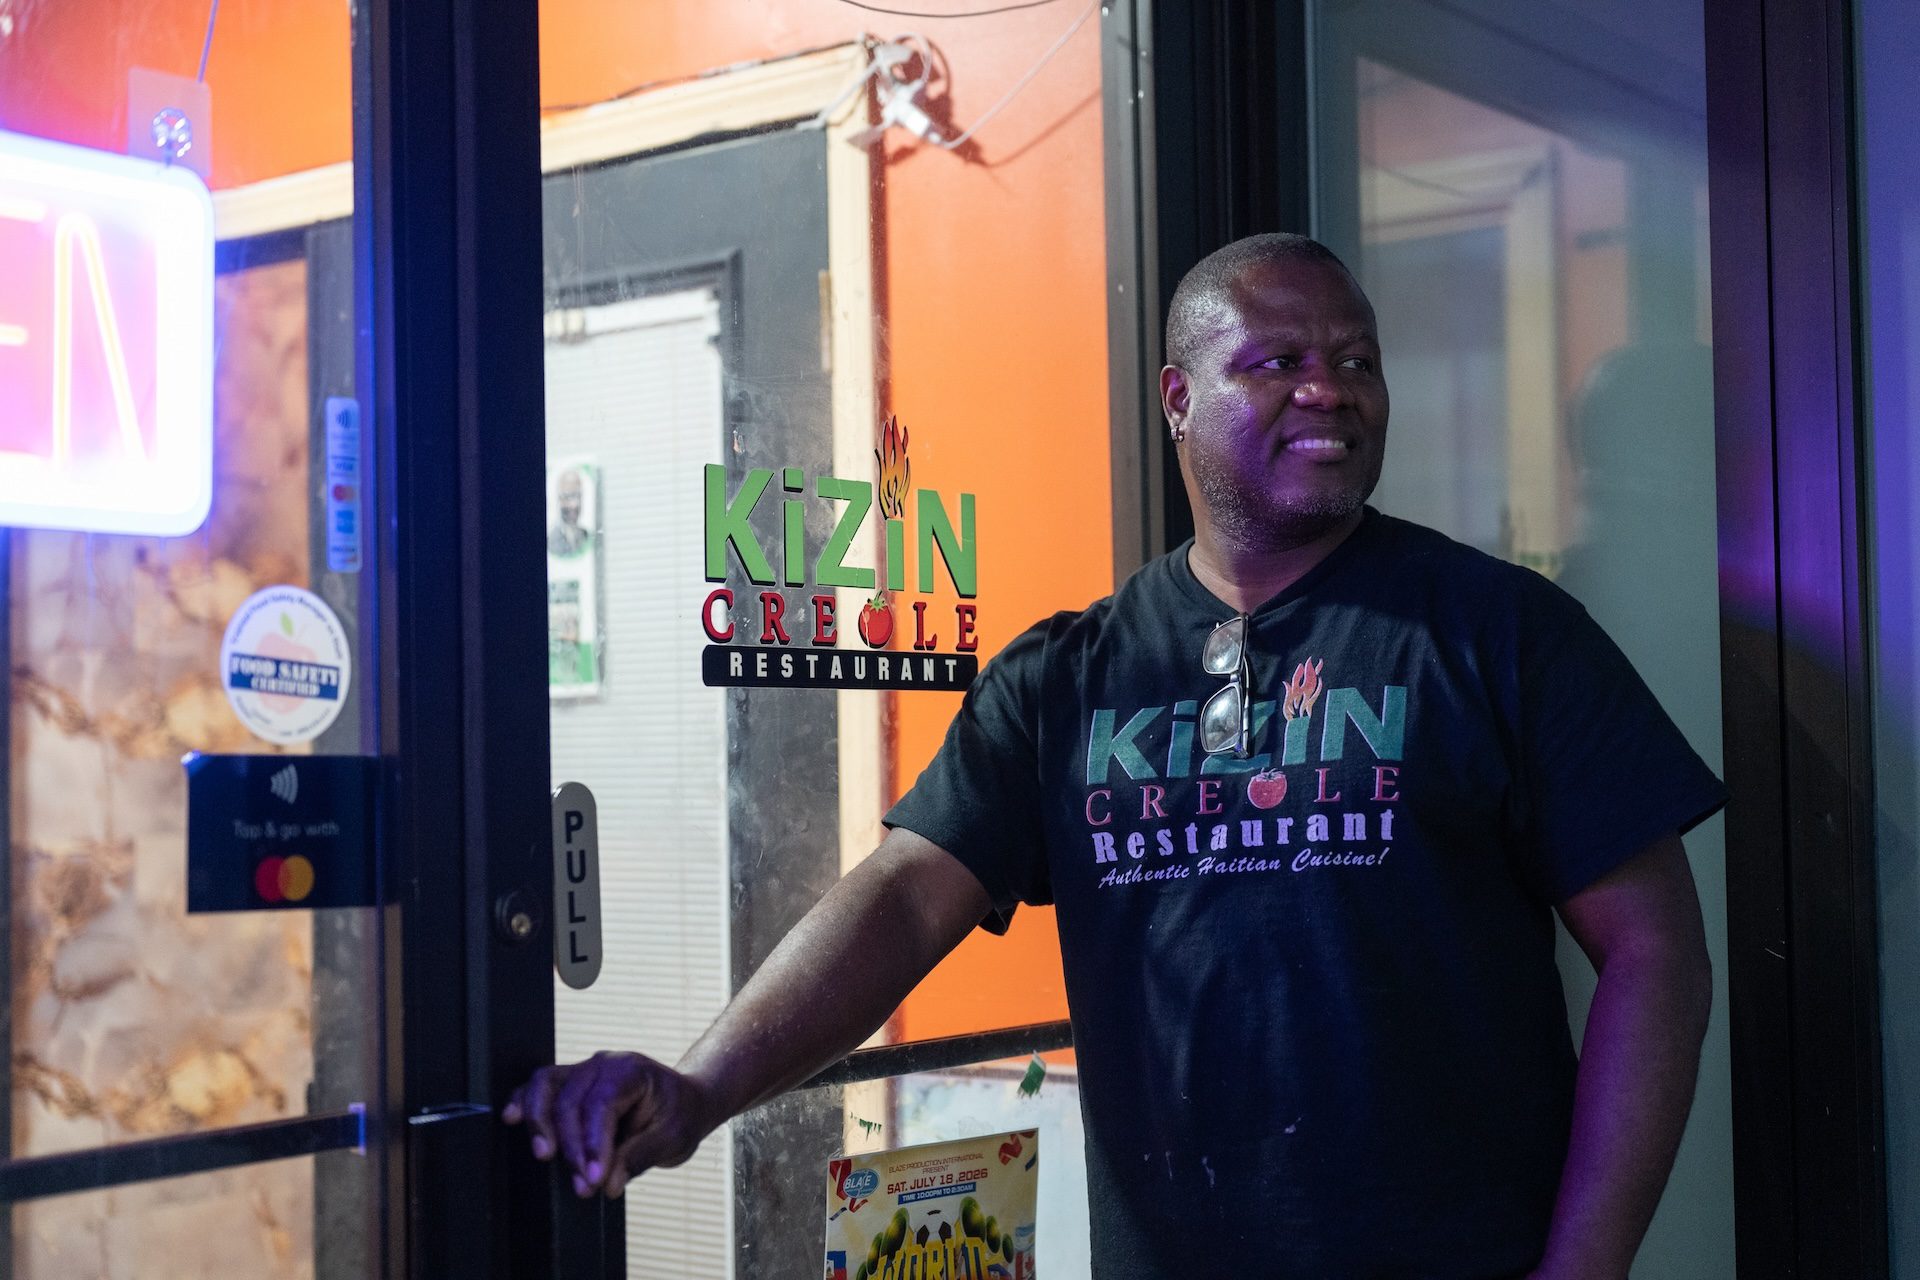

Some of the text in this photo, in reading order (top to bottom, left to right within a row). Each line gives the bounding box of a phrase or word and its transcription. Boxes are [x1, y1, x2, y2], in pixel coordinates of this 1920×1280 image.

[231, 655, 339, 686] FOOD SAFETY
[730, 651, 958, 682] RESTAURANT
[233, 819, 340, 841] Tap & go with
[1091, 809, 1395, 864] Restaurant
[1098, 847, 1391, 889] Authentic Haitian Cuisine!
[565, 810, 589, 964] PULL
[907, 1160, 942, 1171] PRODUCTION
[942, 1154, 984, 1166] INTERNATIONAL
[922, 1165, 949, 1175] PRESENT
[887, 1180, 908, 1195] SAT.
[910, 1176, 936, 1190] JULY
[940, 1173, 955, 1185] 18
[902, 1193, 916, 1202] TIME
[917, 1189, 942, 1200] 10:00PM
[942, 1187, 951, 1196] TO
